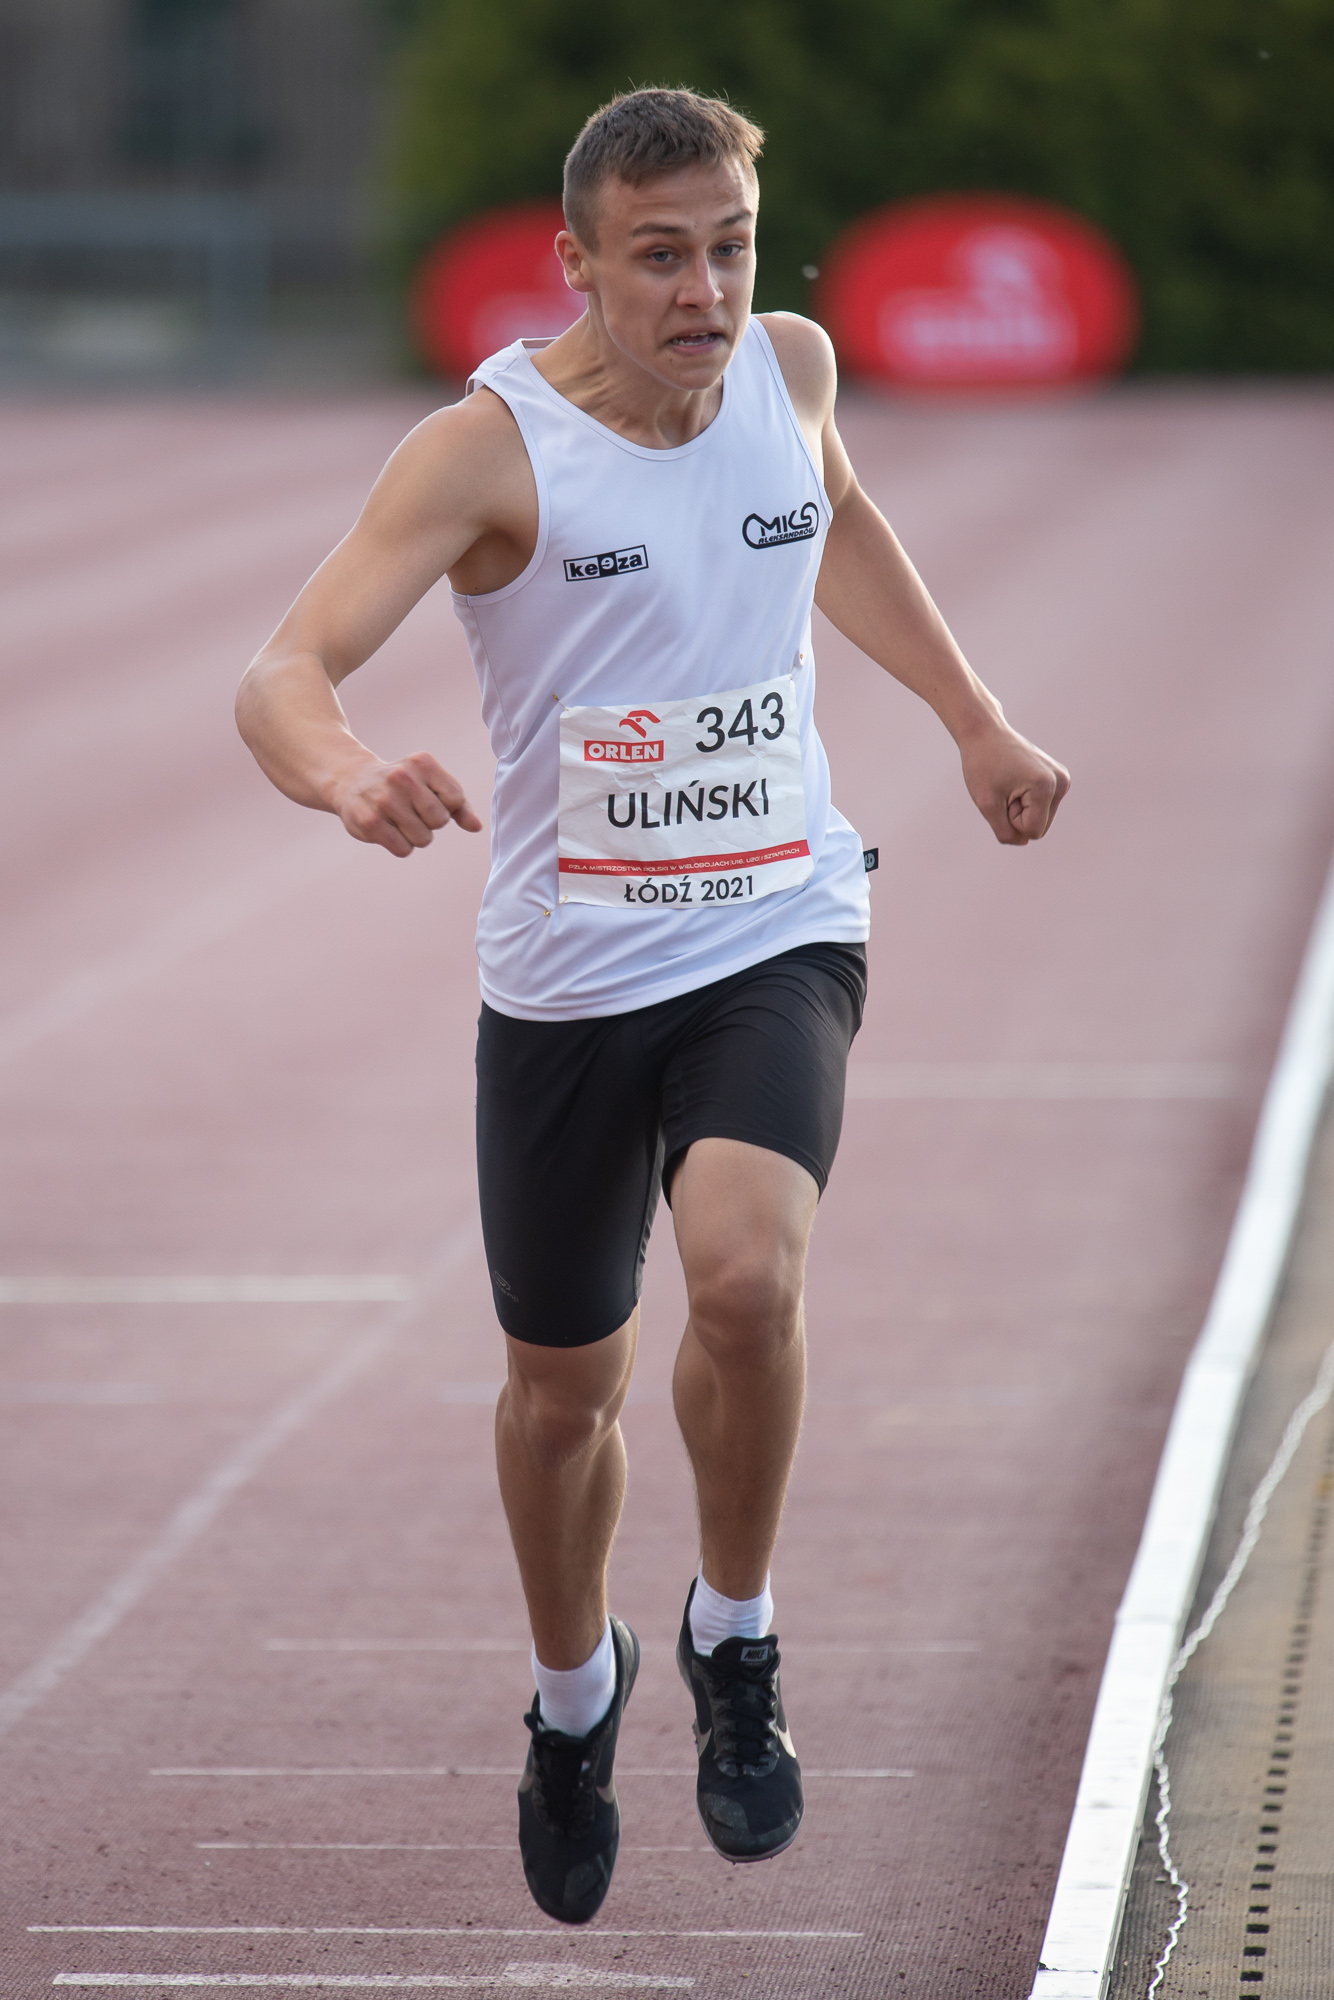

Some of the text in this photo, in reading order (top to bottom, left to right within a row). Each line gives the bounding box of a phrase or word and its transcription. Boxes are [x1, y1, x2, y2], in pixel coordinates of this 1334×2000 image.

[569, 552, 643, 578] keeza
[695, 691, 785, 753] 343
[587, 743, 660, 760] ORLEN
[607, 778, 769, 829] ULIŃSKI
[643, 865, 669, 873] POLSKI
[678, 860, 730, 870] WIELOBOJACH
[624, 875, 754, 904] ŁÓDŹ 2021
[744, 1648, 767, 1660] NIKE
